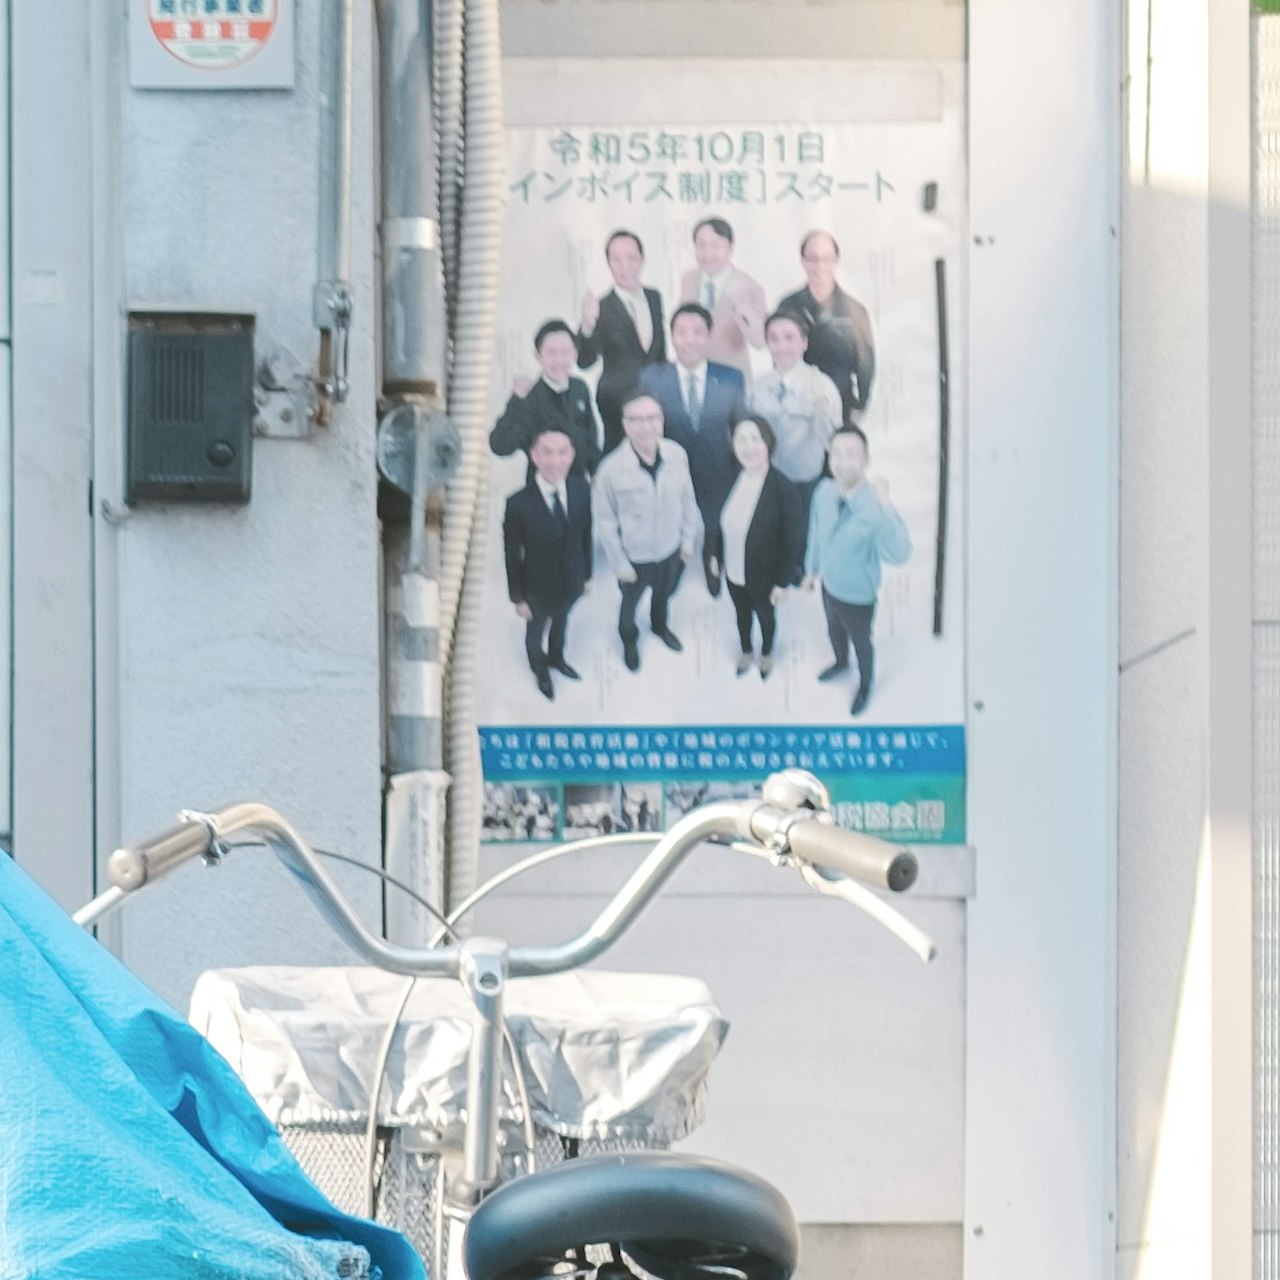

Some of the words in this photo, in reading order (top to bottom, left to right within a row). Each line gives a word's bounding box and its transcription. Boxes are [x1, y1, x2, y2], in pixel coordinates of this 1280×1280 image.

[549, 131, 825, 166] 令和5年10月1日
